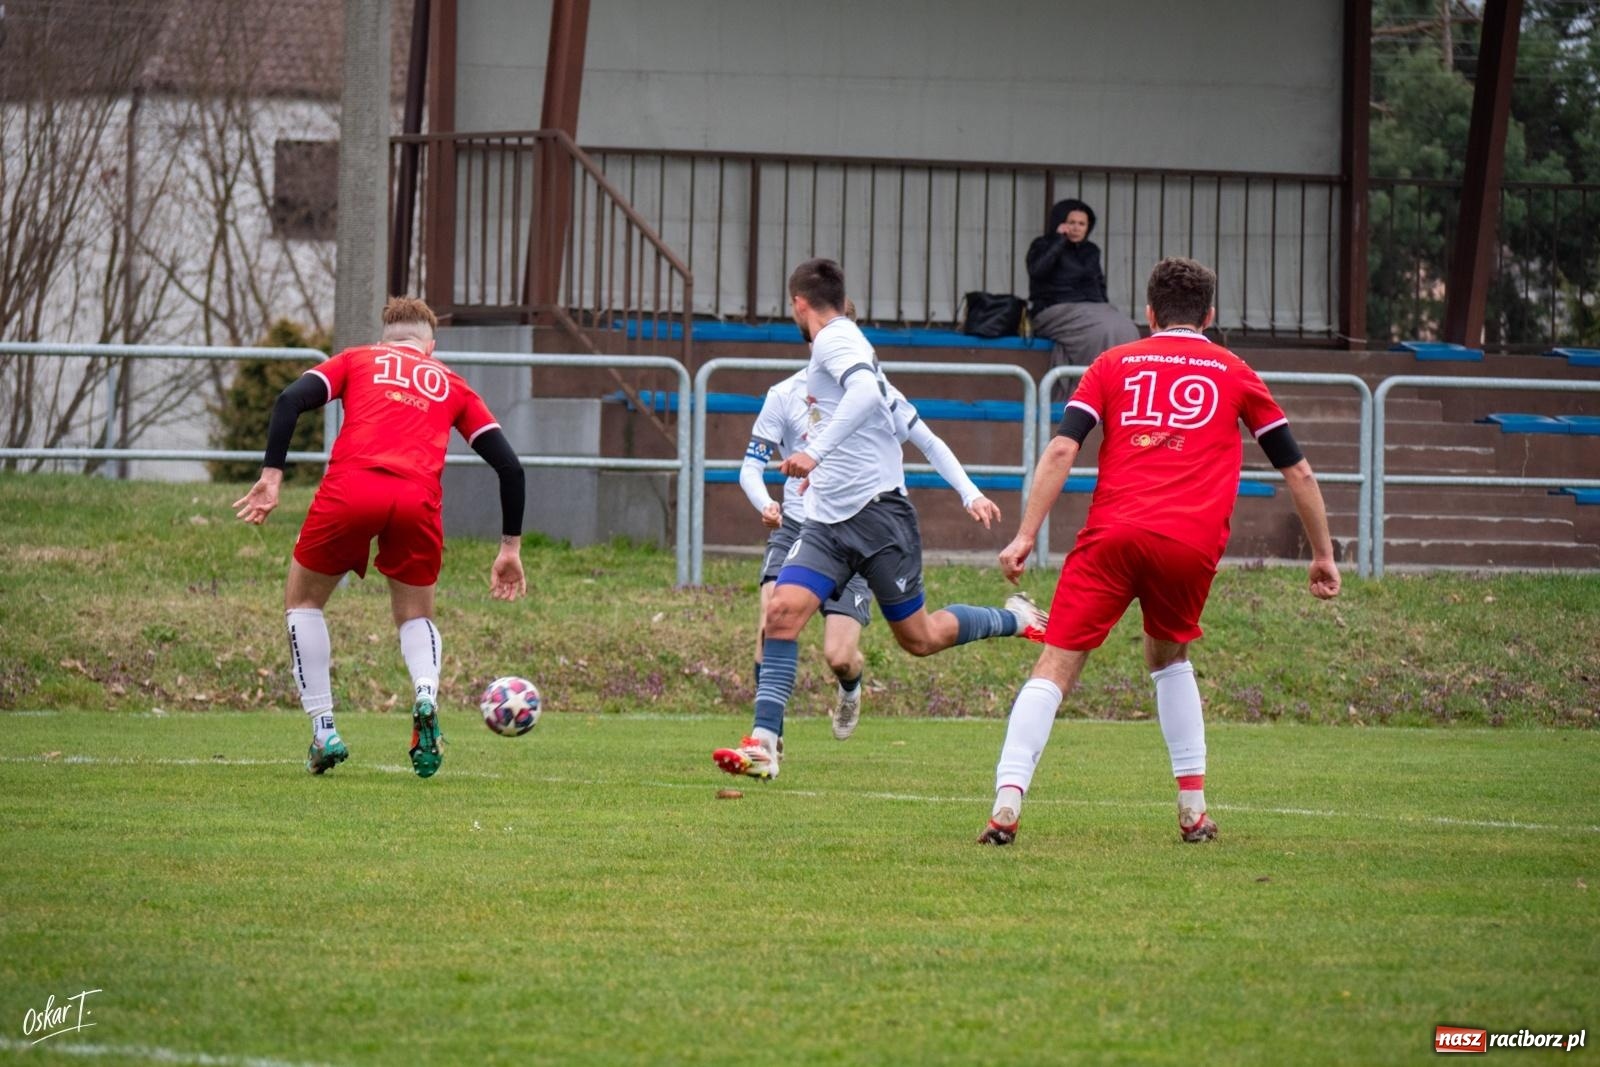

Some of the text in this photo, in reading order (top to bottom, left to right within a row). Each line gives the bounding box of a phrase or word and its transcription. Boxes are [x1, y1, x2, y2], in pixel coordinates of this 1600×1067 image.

[373, 352, 450, 403] 10
[1122, 354, 1228, 372] PRZYSZŁOŚĆ ROGÓW
[1121, 370, 1219, 430] 19
